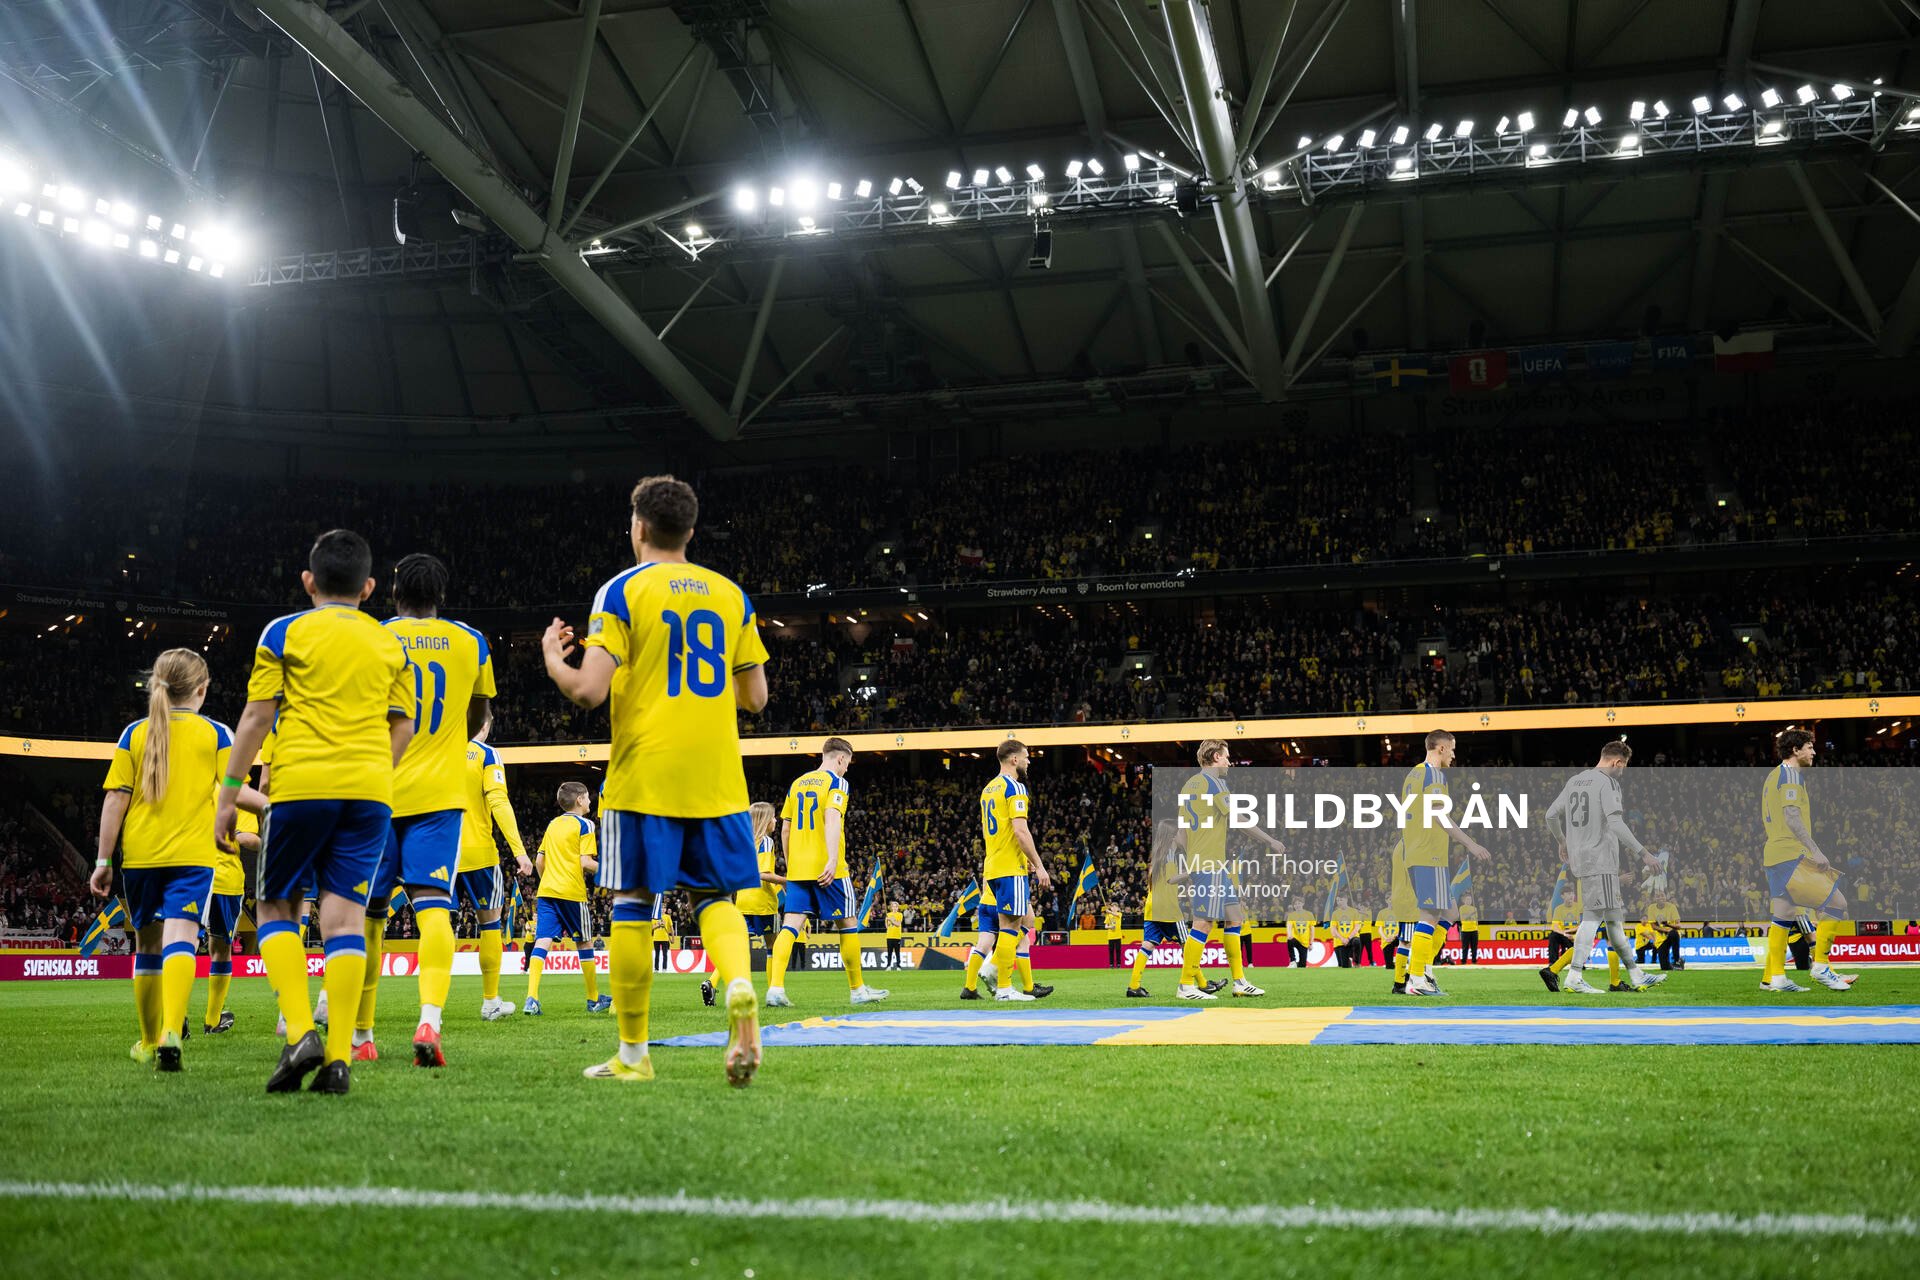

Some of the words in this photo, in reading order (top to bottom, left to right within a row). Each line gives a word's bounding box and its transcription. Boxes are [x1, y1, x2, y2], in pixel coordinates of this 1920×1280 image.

[1657, 346, 1687, 360] FIFA
[1523, 358, 1563, 374] UEFA
[1441, 389, 1579, 417] Strawberry
[1591, 385, 1666, 404] Arena
[987, 586, 1038, 598] Strawberry
[1039, 584, 1068, 595] Arena
[1096, 582, 1124, 592] Room
[1125, 581, 1139, 591] for
[1140, 579, 1185, 590] emotions
[16, 592, 74, 606] Strawberry
[75, 598, 105, 609] Arena
[136, 603, 166, 614] Room
[167, 606, 182, 615] for
[183, 608, 229, 618] emotions
[661, 609, 726, 698] 18
[797, 791, 818, 831] 17
[1569, 791, 1590, 828] 23
[1879, 943, 1920, 956] QUALI
[24, 958, 73, 977] SVENSKA
[75, 958, 100, 977] SPEL
